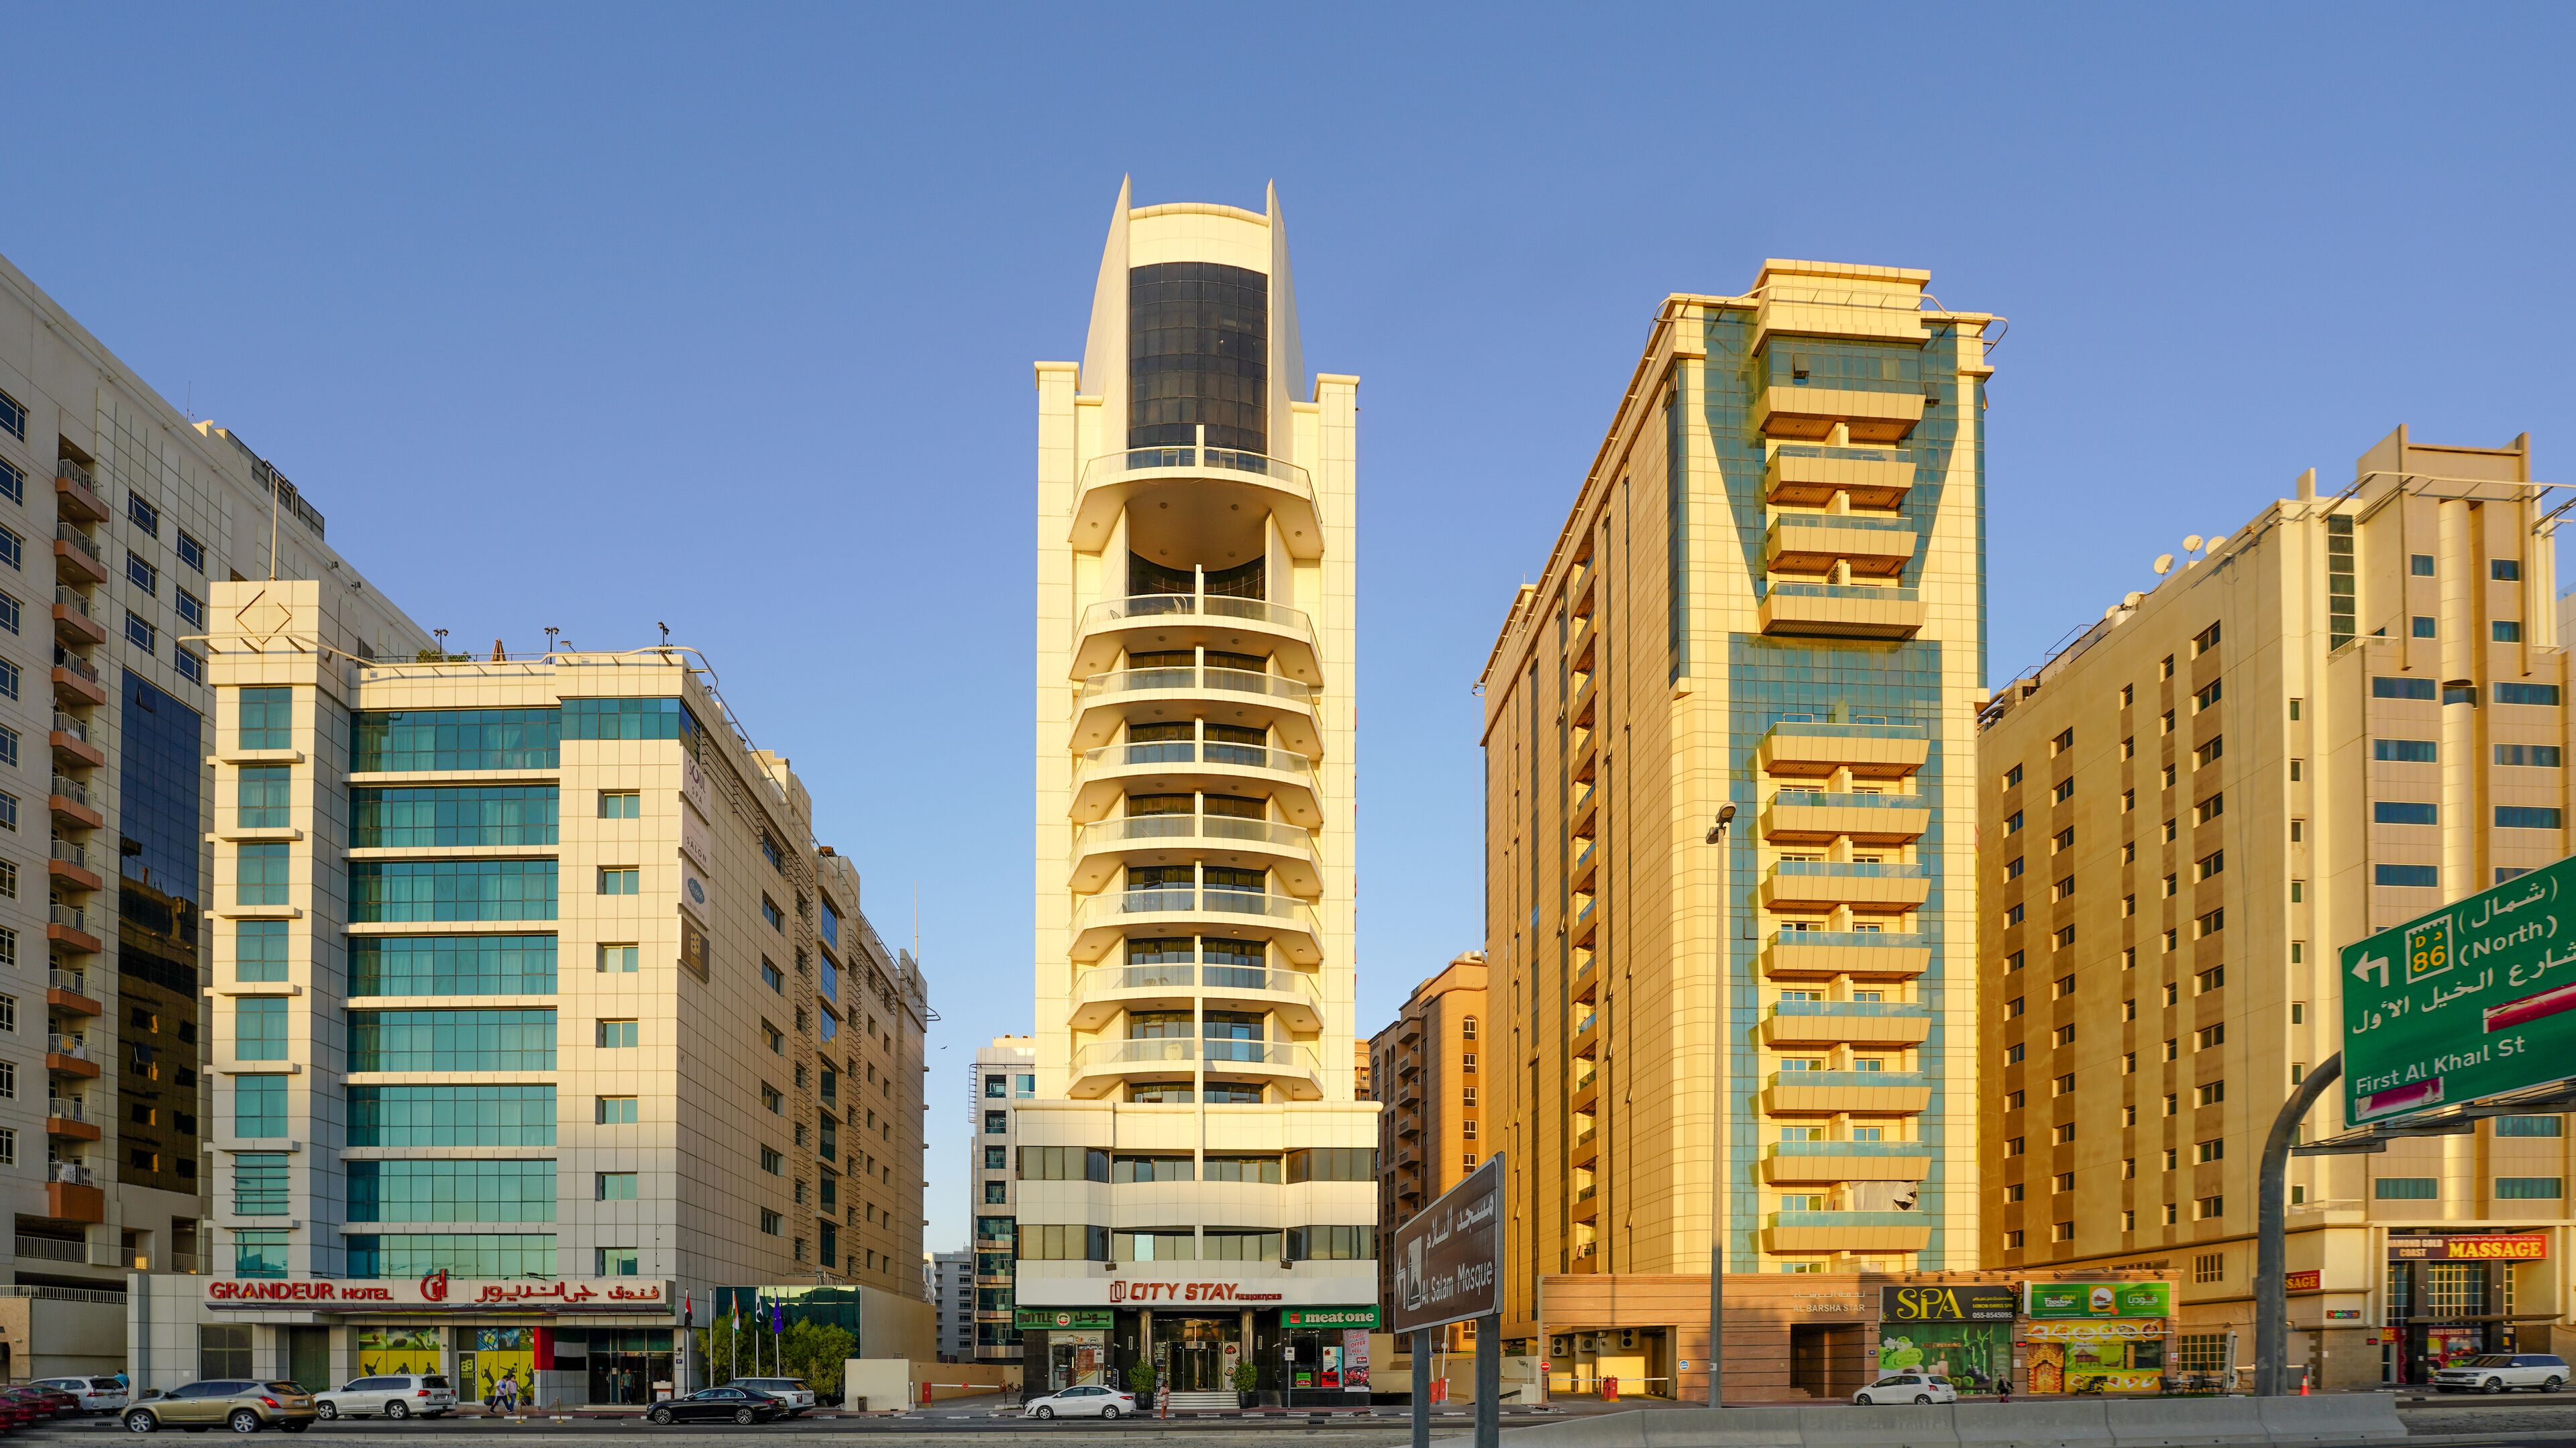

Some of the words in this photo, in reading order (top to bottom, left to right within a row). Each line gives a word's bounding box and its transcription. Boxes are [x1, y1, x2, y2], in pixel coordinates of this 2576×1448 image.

[689, 759, 706, 794] SOUL
[692, 787, 702, 805] SPA
[687, 836, 706, 862] SALON
[2416, 936, 2426, 948] D
[2459, 915, 2558, 966] (North)
[2412, 945, 2447, 972] 86
[2421, 967, 2494, 1012] الخيل
[2356, 1070, 2400, 1094] First
[2406, 1062, 2427, 1081] Al
[2434, 1044, 2491, 1074] Khail
[2498, 1036, 2525, 1056] St
[1456, 1194, 1494, 1234] مسجد
[1426, 1203, 1452, 1268] السلام
[2422, 1239, 2443, 1247] GOLD
[2399, 1248, 2427, 1257] COAST
[2448, 1242, 2542, 1258] MASSAGE
[209, 1282, 335, 1300] GRANDEUR
[341, 1288, 394, 1300] HOTEL
[475, 1281, 598, 1302] جرانديور
[1130, 1282, 1180, 1300] CITY
[1185, 1282, 1239, 1300] STAY
[1421, 1278, 1429, 1305] Al
[1431, 1274, 1454, 1302] Salam
[1457, 1261, 1493, 1296] Mosque
[608, 1286, 660, 1300] فندق
[1838, 1290, 1866, 1299] نجمة
[1792, 1304, 1804, 1313] AL
[1806, 1304, 1841, 1313] BARSHA
[1843, 1304, 1865, 1312] STAR
[1896, 1288, 1966, 1319] SPA
[1018, 1313, 1053, 1323] BOTTLE
[1305, 1312, 1344, 1323] meat
[1345, 1313, 1375, 1322] one
[1350, 1340, 1366, 1348] OFFER
